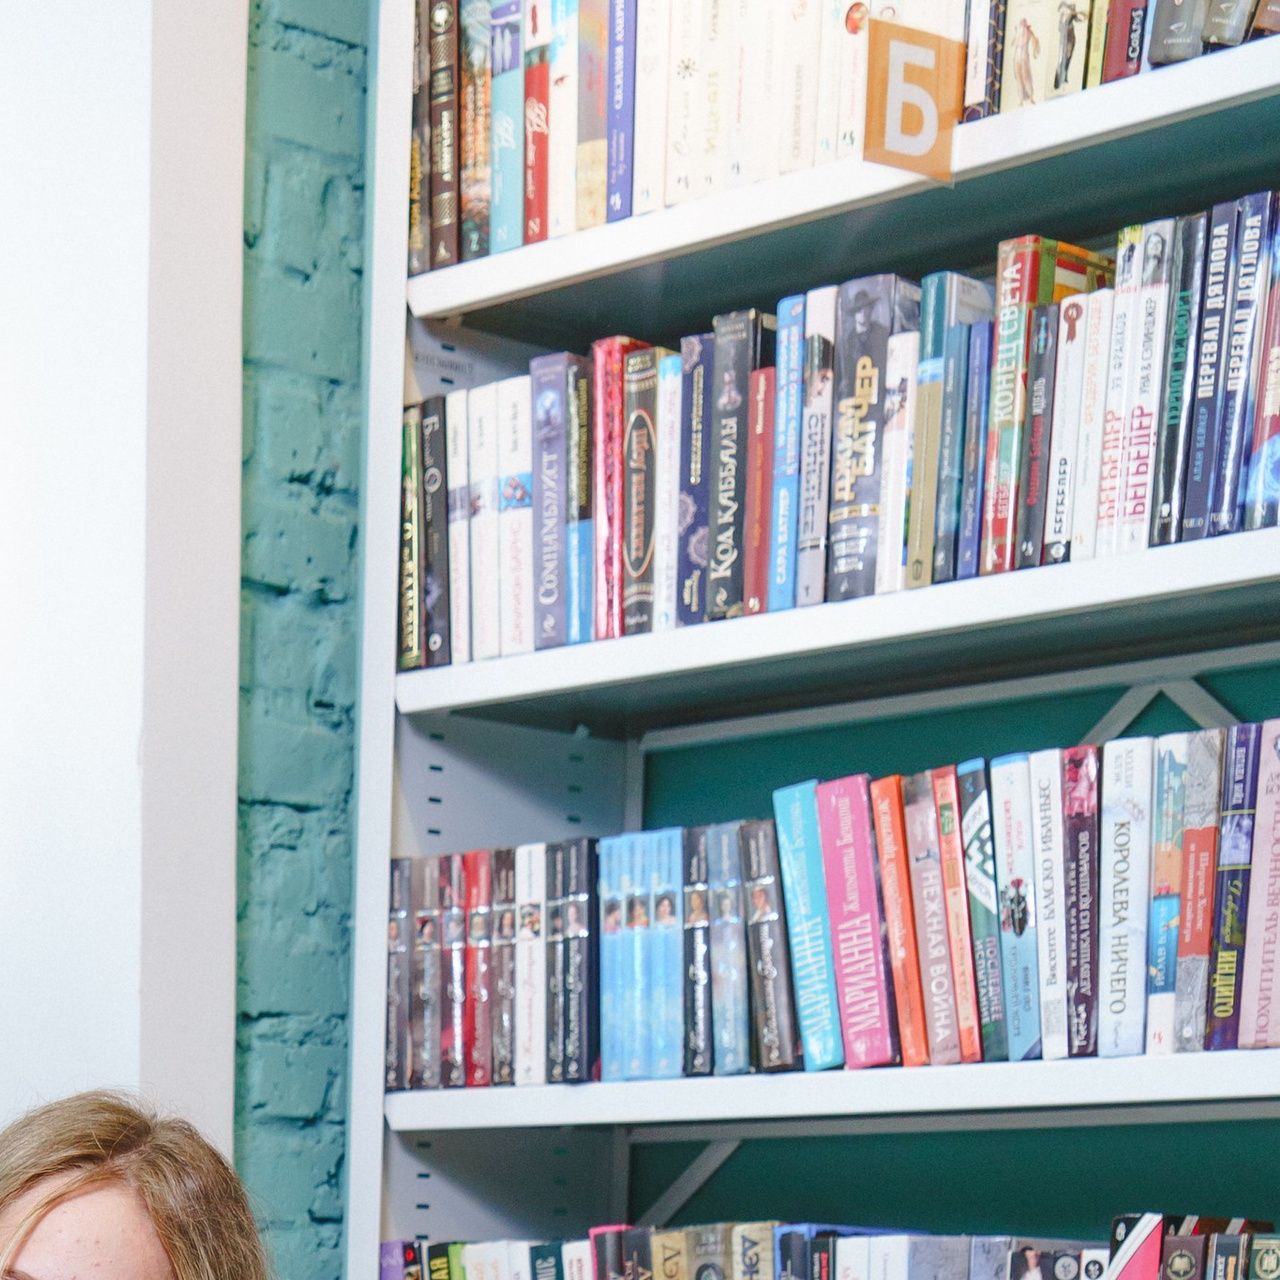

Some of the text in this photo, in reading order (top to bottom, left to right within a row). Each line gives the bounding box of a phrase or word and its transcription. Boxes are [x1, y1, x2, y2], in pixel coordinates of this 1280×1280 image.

[883, 39, 939, 156] Б
[1197, 224, 1230, 398] ПЕРЕВАЛ ДЯТЛОВА
[1234, 214, 1262, 302] ДЯТЛОВА
[994, 262, 1024, 422] КОНЕЦ СВЕТА
[1226, 309, 1253, 391] ПЕРЕВАЛ
[835, 355, 879, 502] ДЖИМ БАТЧЕР
[709, 416, 739, 579] КОД КАББАЛЫ
[1038, 858, 1056, 921] БЛАСКО
[1078, 830, 1093, 909] КОШМАРОВ
[1079, 909, 1091, 930] ИЗ
[1109, 821, 1132, 1015] КОРОЛЕВА НИЧЕГО
[793, 916, 833, 1037] МАРИАННА
[836, 912, 880, 1036] МАРИАННА
[921, 871, 953, 1043] НЕЖНАЯ ВОЙНА
[974, 938, 991, 1025] ИСПЫТАНИЕ
[984, 936, 1004, 1022] ПОСЛЕДНЕЕ
[1079, 931, 1092, 996] ДЕВУШКА
[1210, 949, 1239, 1018] ИНДИГО
[1253, 911, 1280, 1046] ПОХИТИТЕЛЬ
